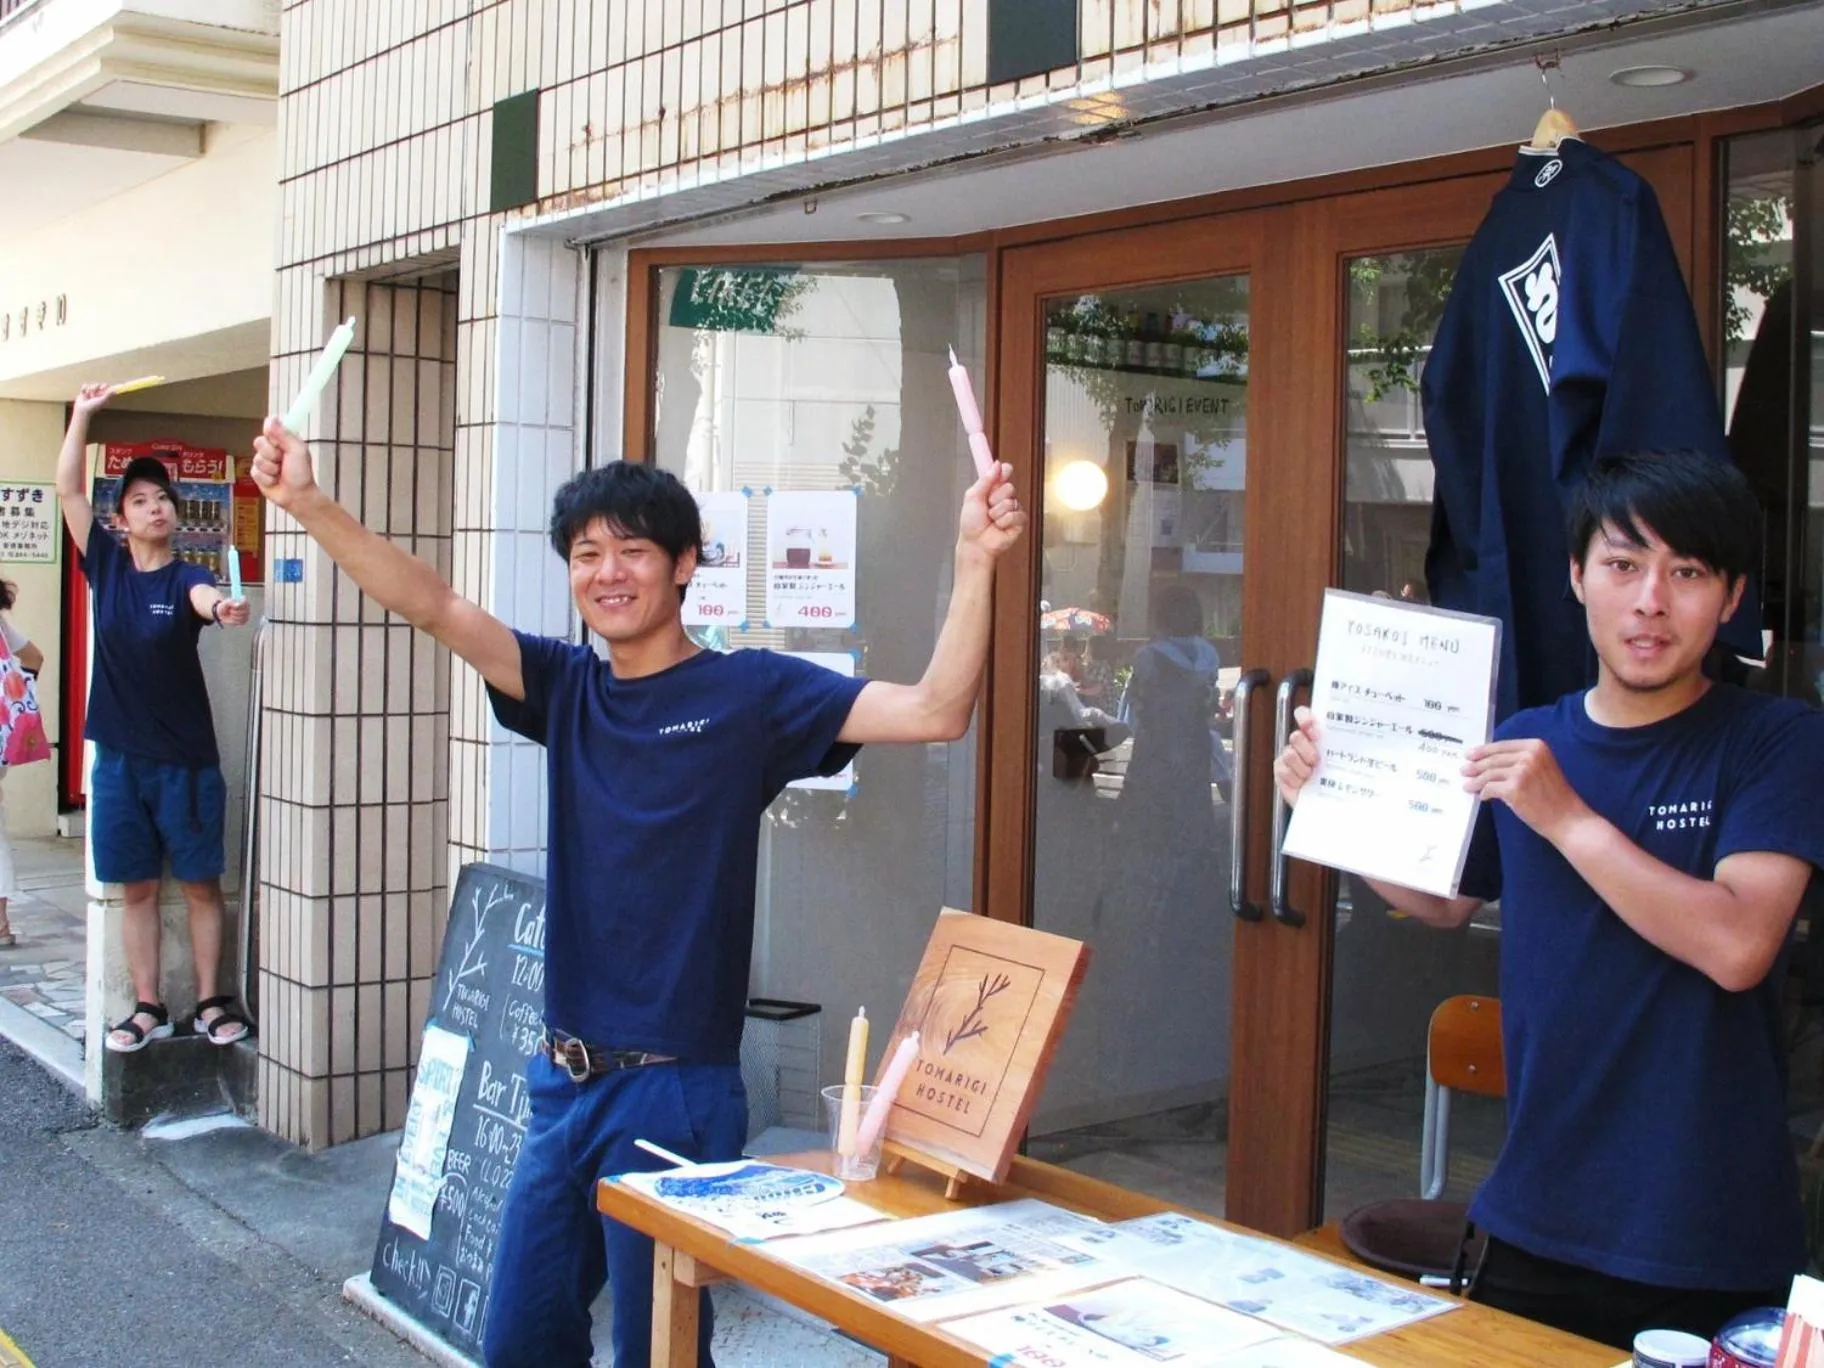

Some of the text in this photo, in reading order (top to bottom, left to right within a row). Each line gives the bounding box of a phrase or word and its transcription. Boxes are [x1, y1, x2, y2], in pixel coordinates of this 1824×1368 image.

[1, 487, 44, 503] すずき
[798, 605, 832, 618] 400
[1419, 634, 1461, 655] MENU
[1649, 800, 1713, 816] TOMARIG
[1656, 816, 1710, 830] HOSTEL
[478, 1060, 507, 1107] Bar
[916, 1058, 987, 1096] TOMARIGI
[915, 1083, 970, 1115] HOSTEL
